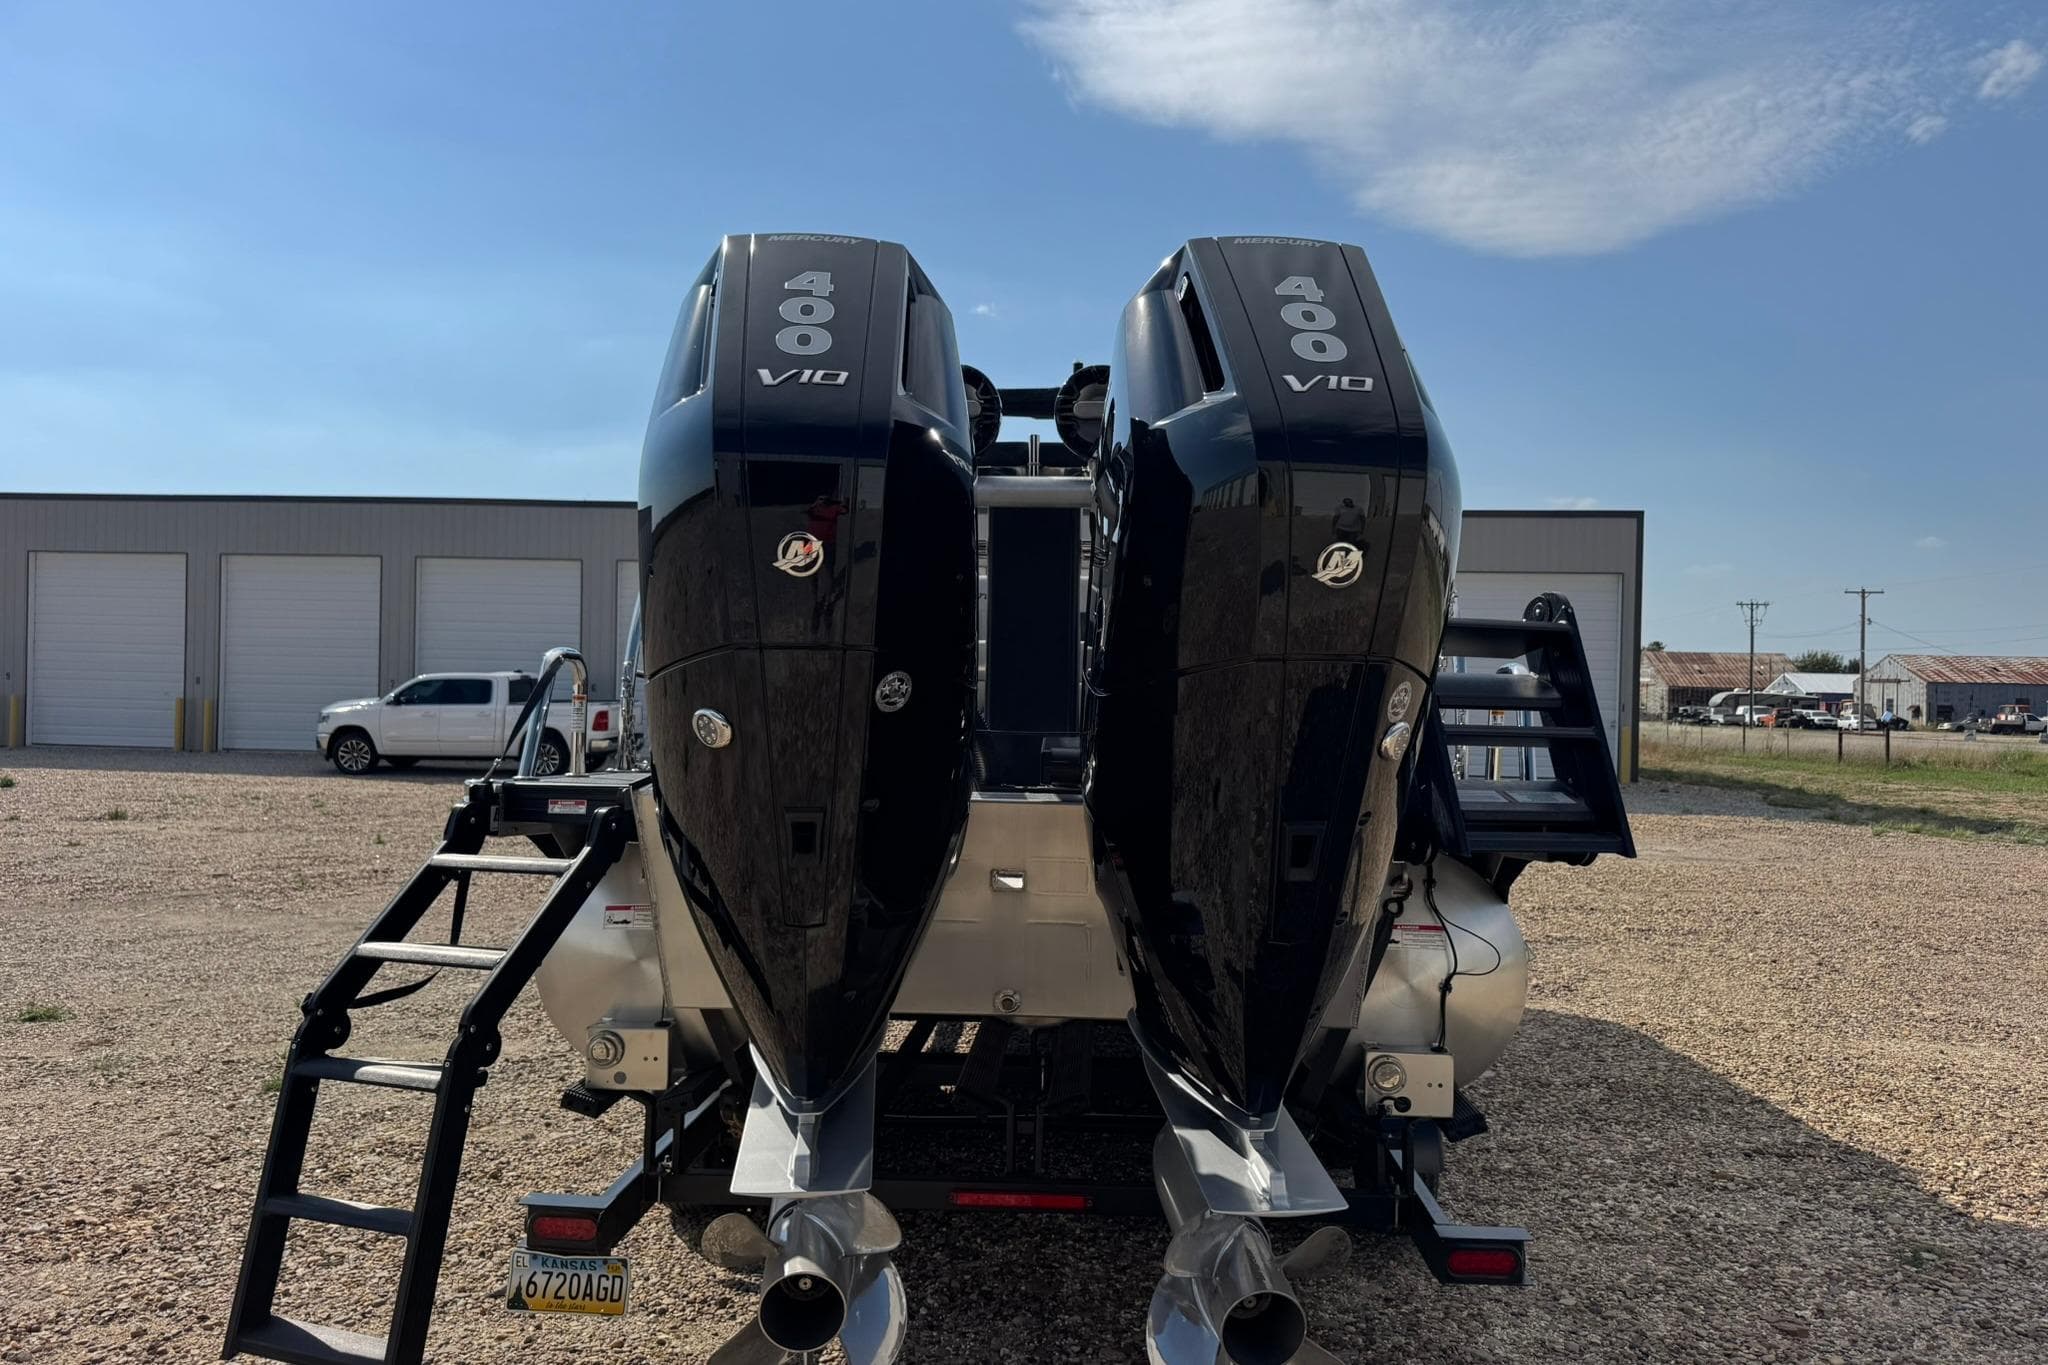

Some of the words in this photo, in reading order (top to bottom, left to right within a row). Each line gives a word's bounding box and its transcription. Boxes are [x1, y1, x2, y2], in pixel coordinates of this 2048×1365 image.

[767, 234, 864, 245] MERCURY
[1233, 237, 1326, 248] MERCURY
[775, 270, 835, 356] 400
[1274, 275, 1348, 363] 400
[757, 367, 850, 387] V10
[1281, 374, 1375, 393] V10
[515, 1255, 529, 1268] EL
[541, 1256, 598, 1271] KANSAS
[525, 1270, 624, 1304] 6720AGD
[545, 1301, 554, 1309] to
[555, 1300, 568, 1310] the
[568, 1302, 587, 1311] stars
